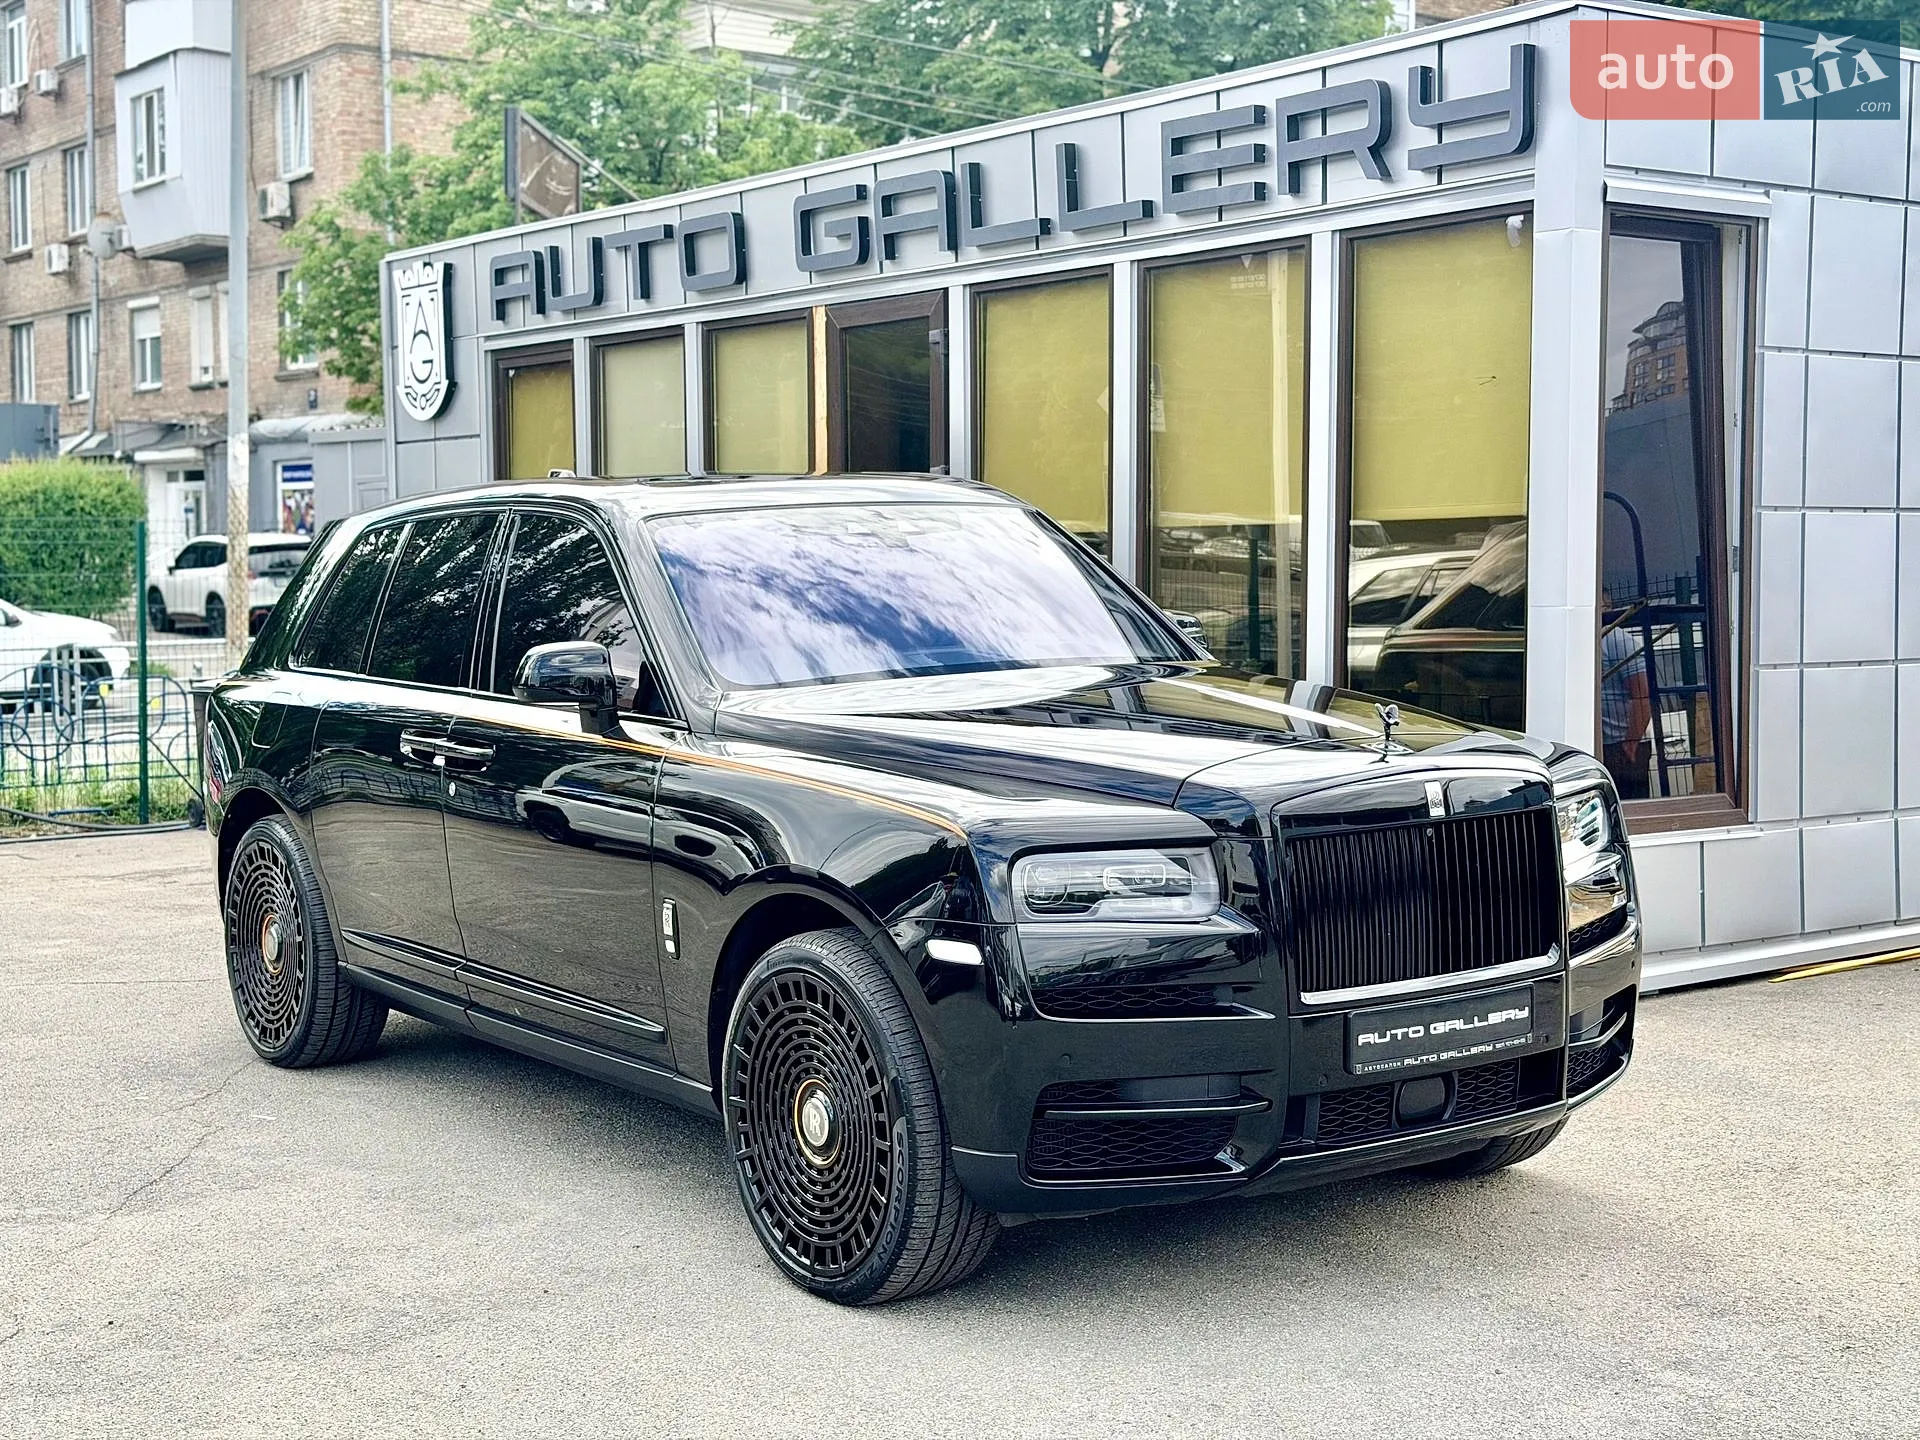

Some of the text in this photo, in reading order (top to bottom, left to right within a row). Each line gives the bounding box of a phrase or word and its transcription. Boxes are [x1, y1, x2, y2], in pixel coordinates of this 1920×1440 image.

[489, 43, 1537, 321] AUTO GALLERY
[1357, 1006, 1529, 1047] AUTO GALLERY
[1403, 1054, 1438, 1067] AUTO
[1439, 1044, 1493, 1060] GALLERY
[877, 1131, 906, 1262] SCORPION
